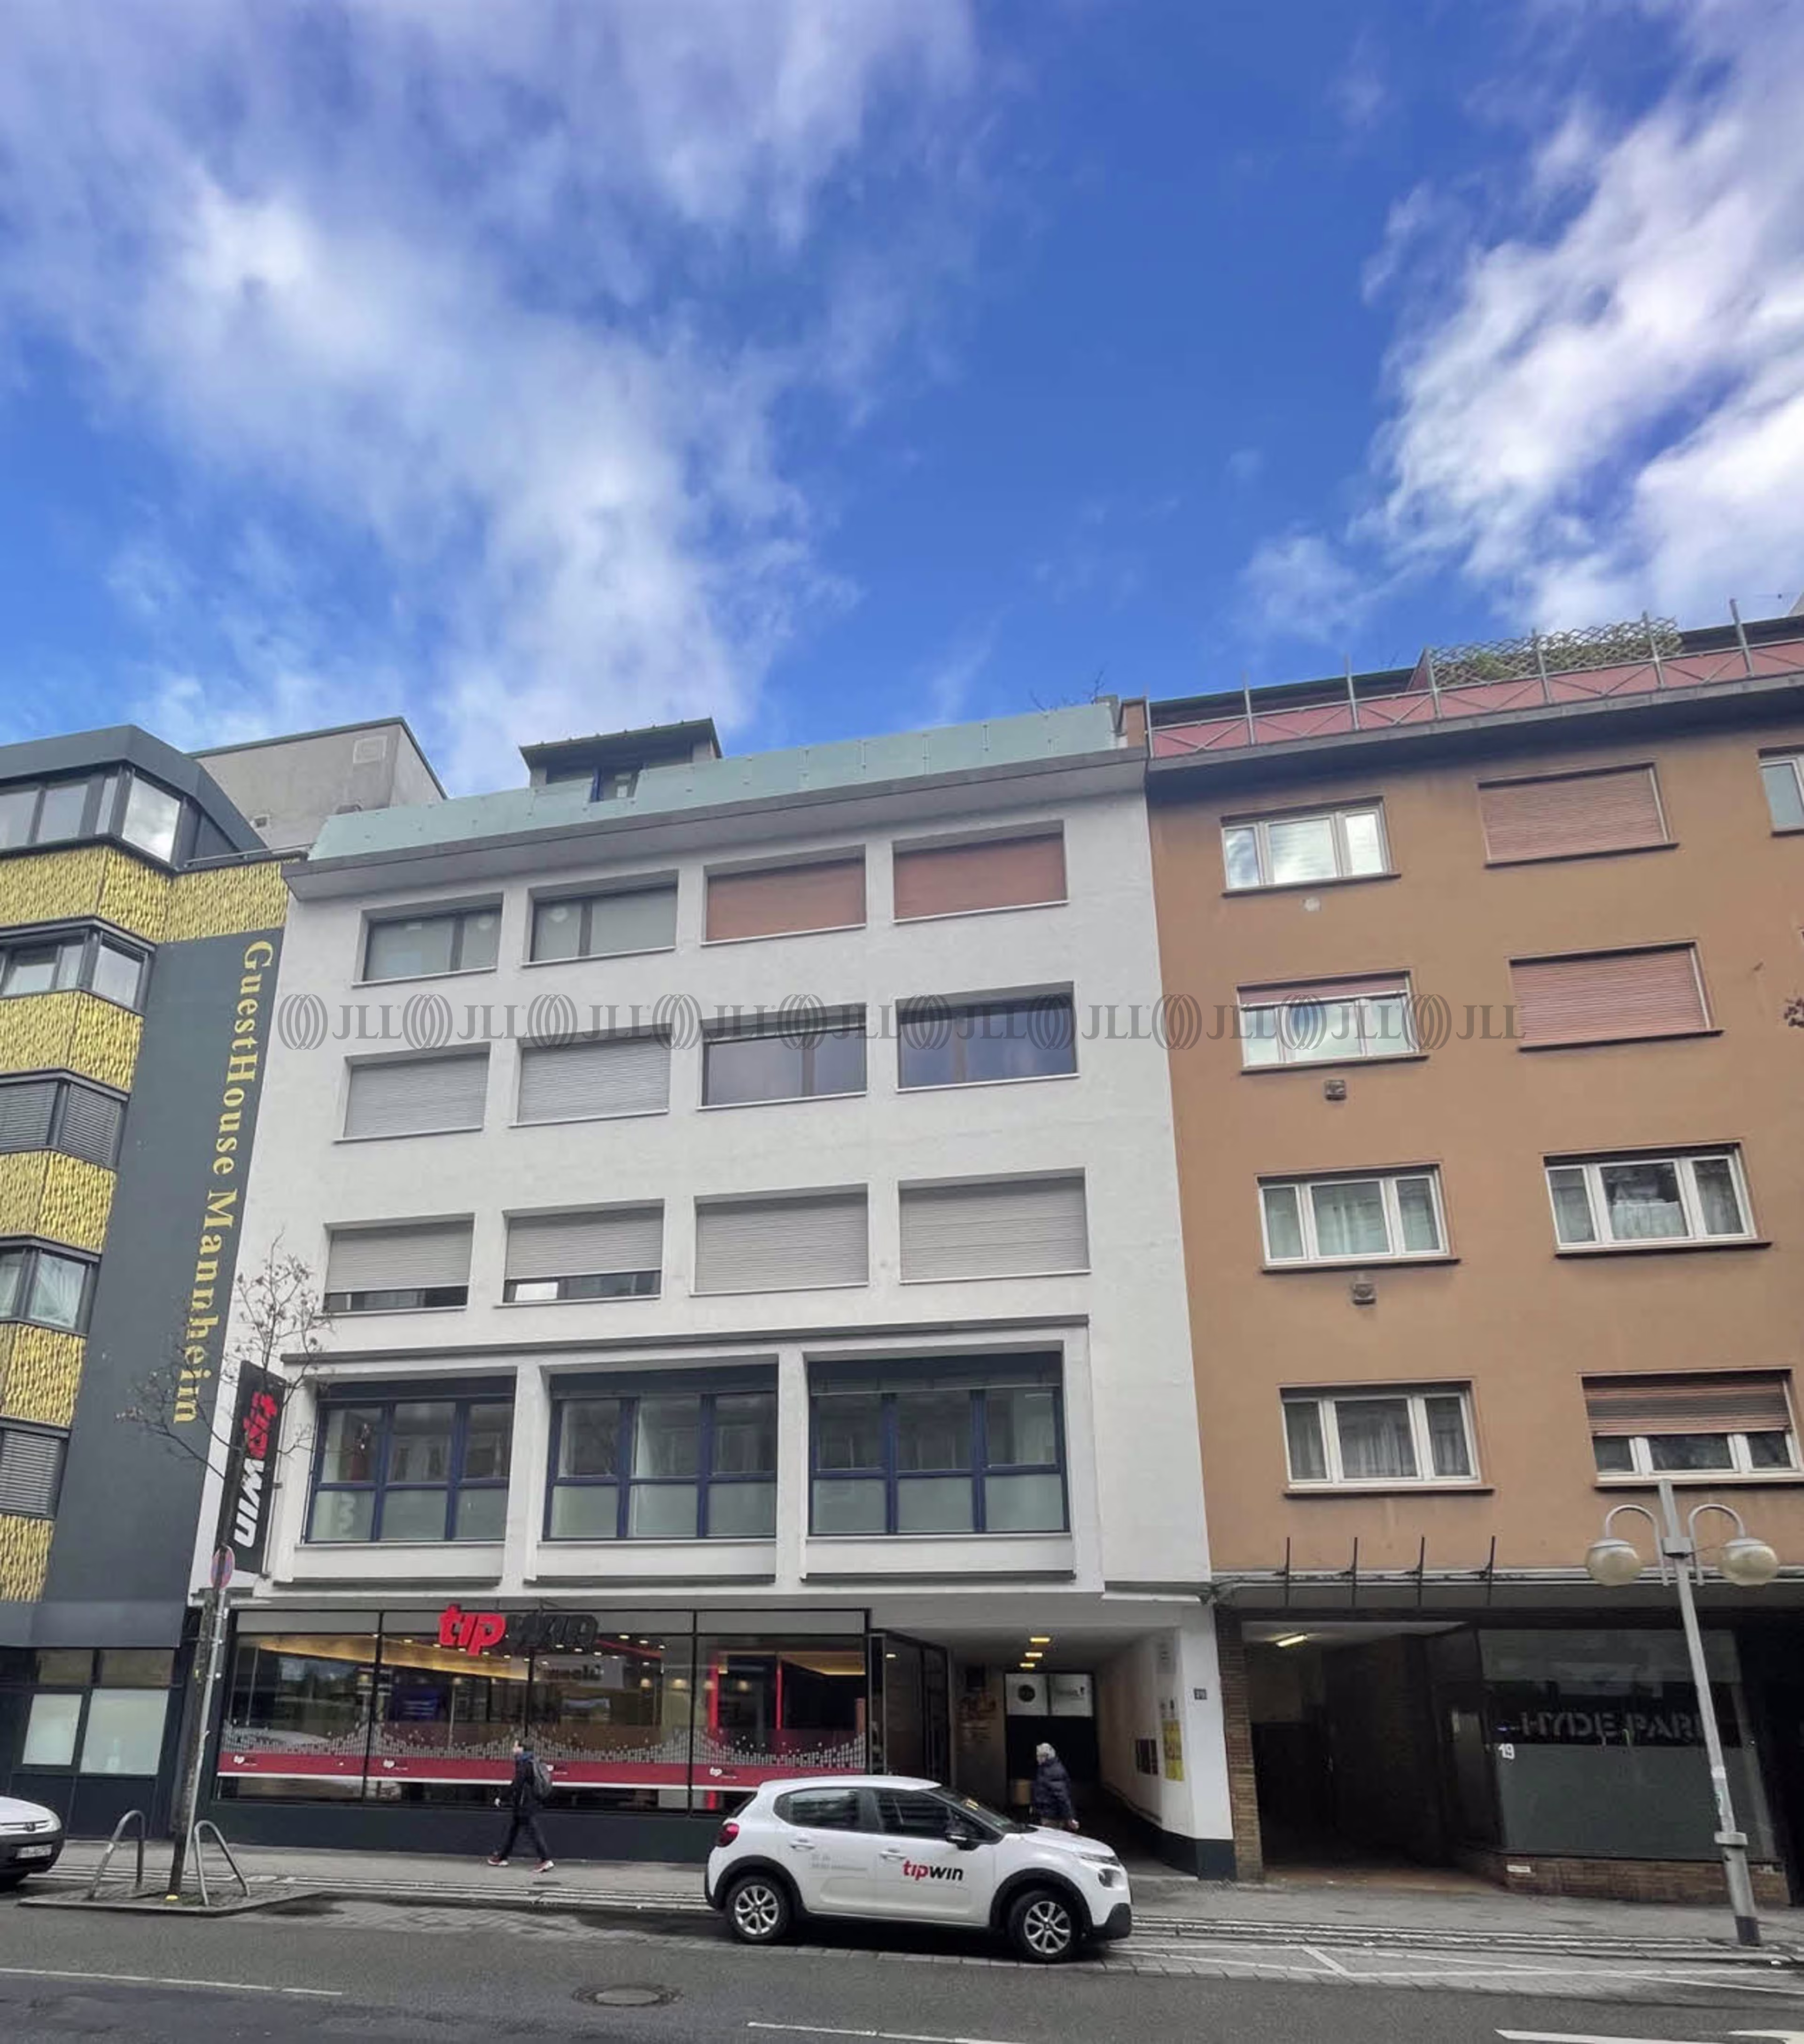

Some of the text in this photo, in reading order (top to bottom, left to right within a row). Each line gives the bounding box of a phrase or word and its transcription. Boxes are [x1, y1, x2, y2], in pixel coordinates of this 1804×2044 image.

[174, 941, 274, 1424] GuestHouse Mannheim
[1519, 1711, 1618, 1737] HYDE
[1498, 1743, 1515, 1760] 19
[902, 1859, 964, 1881] tipwin
